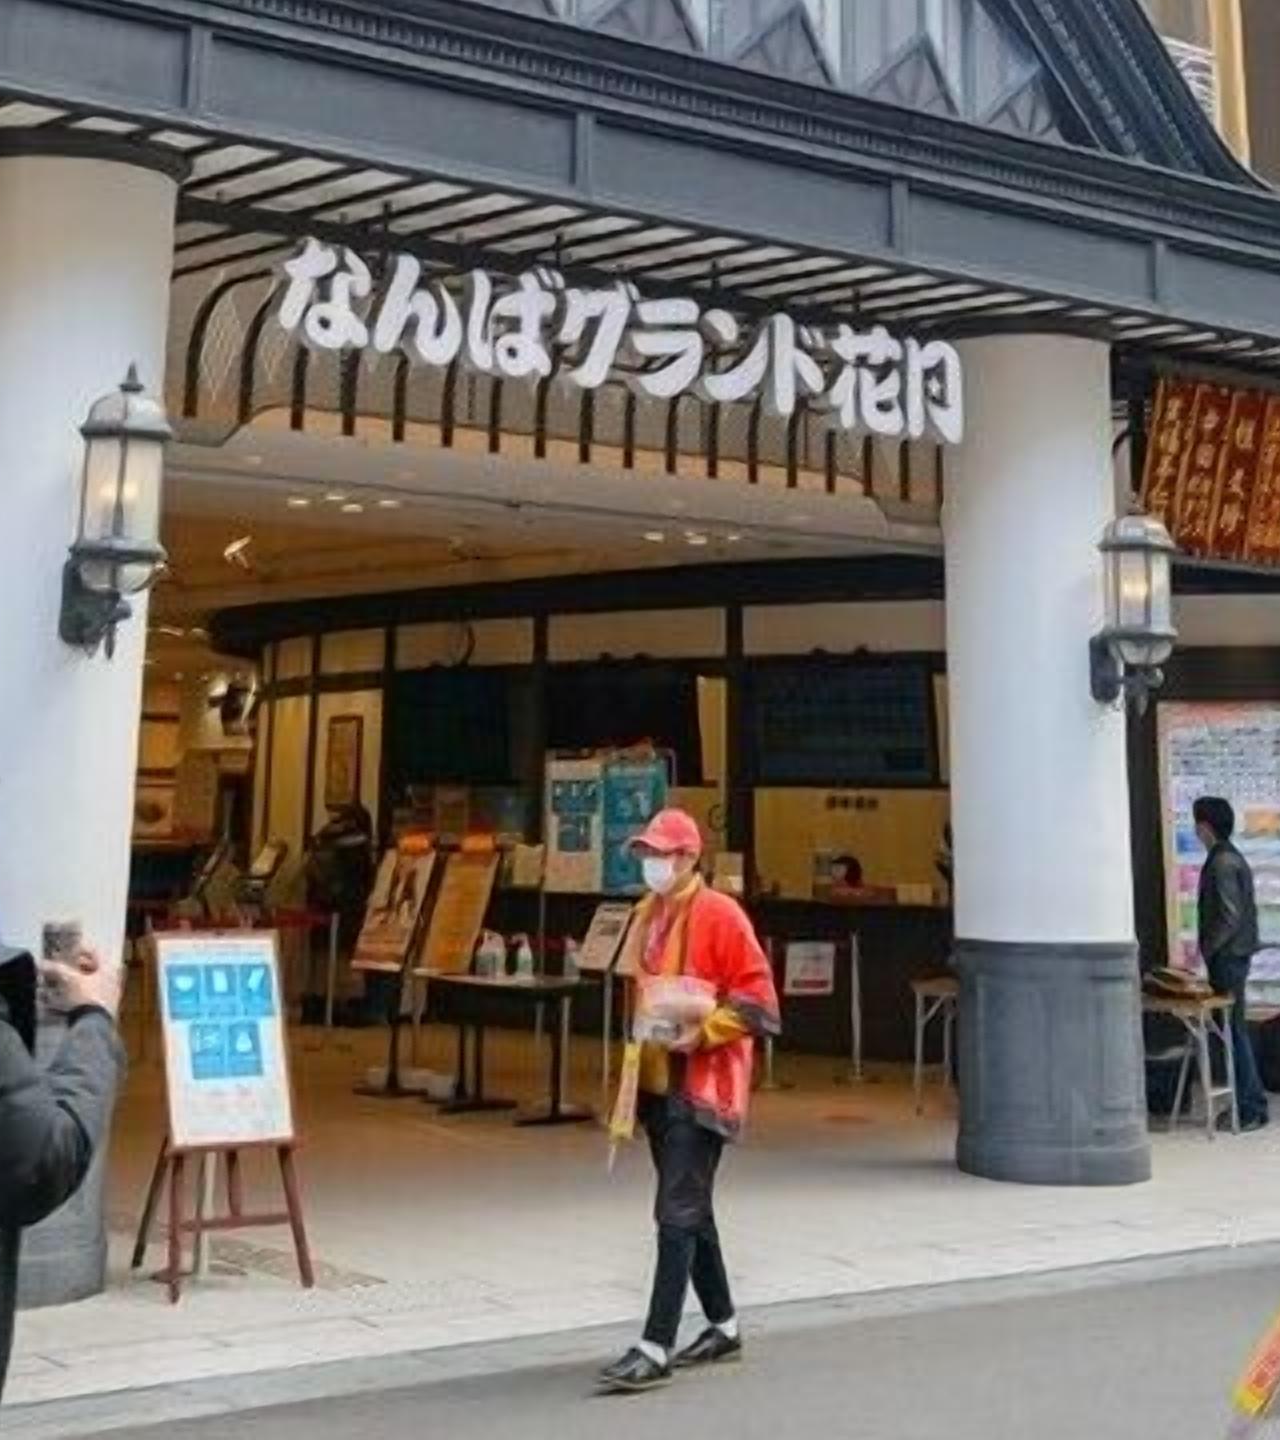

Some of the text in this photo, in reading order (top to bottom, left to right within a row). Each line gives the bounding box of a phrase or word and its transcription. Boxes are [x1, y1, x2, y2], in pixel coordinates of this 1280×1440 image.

[278, 237, 963, 444] なんばグランド花月
